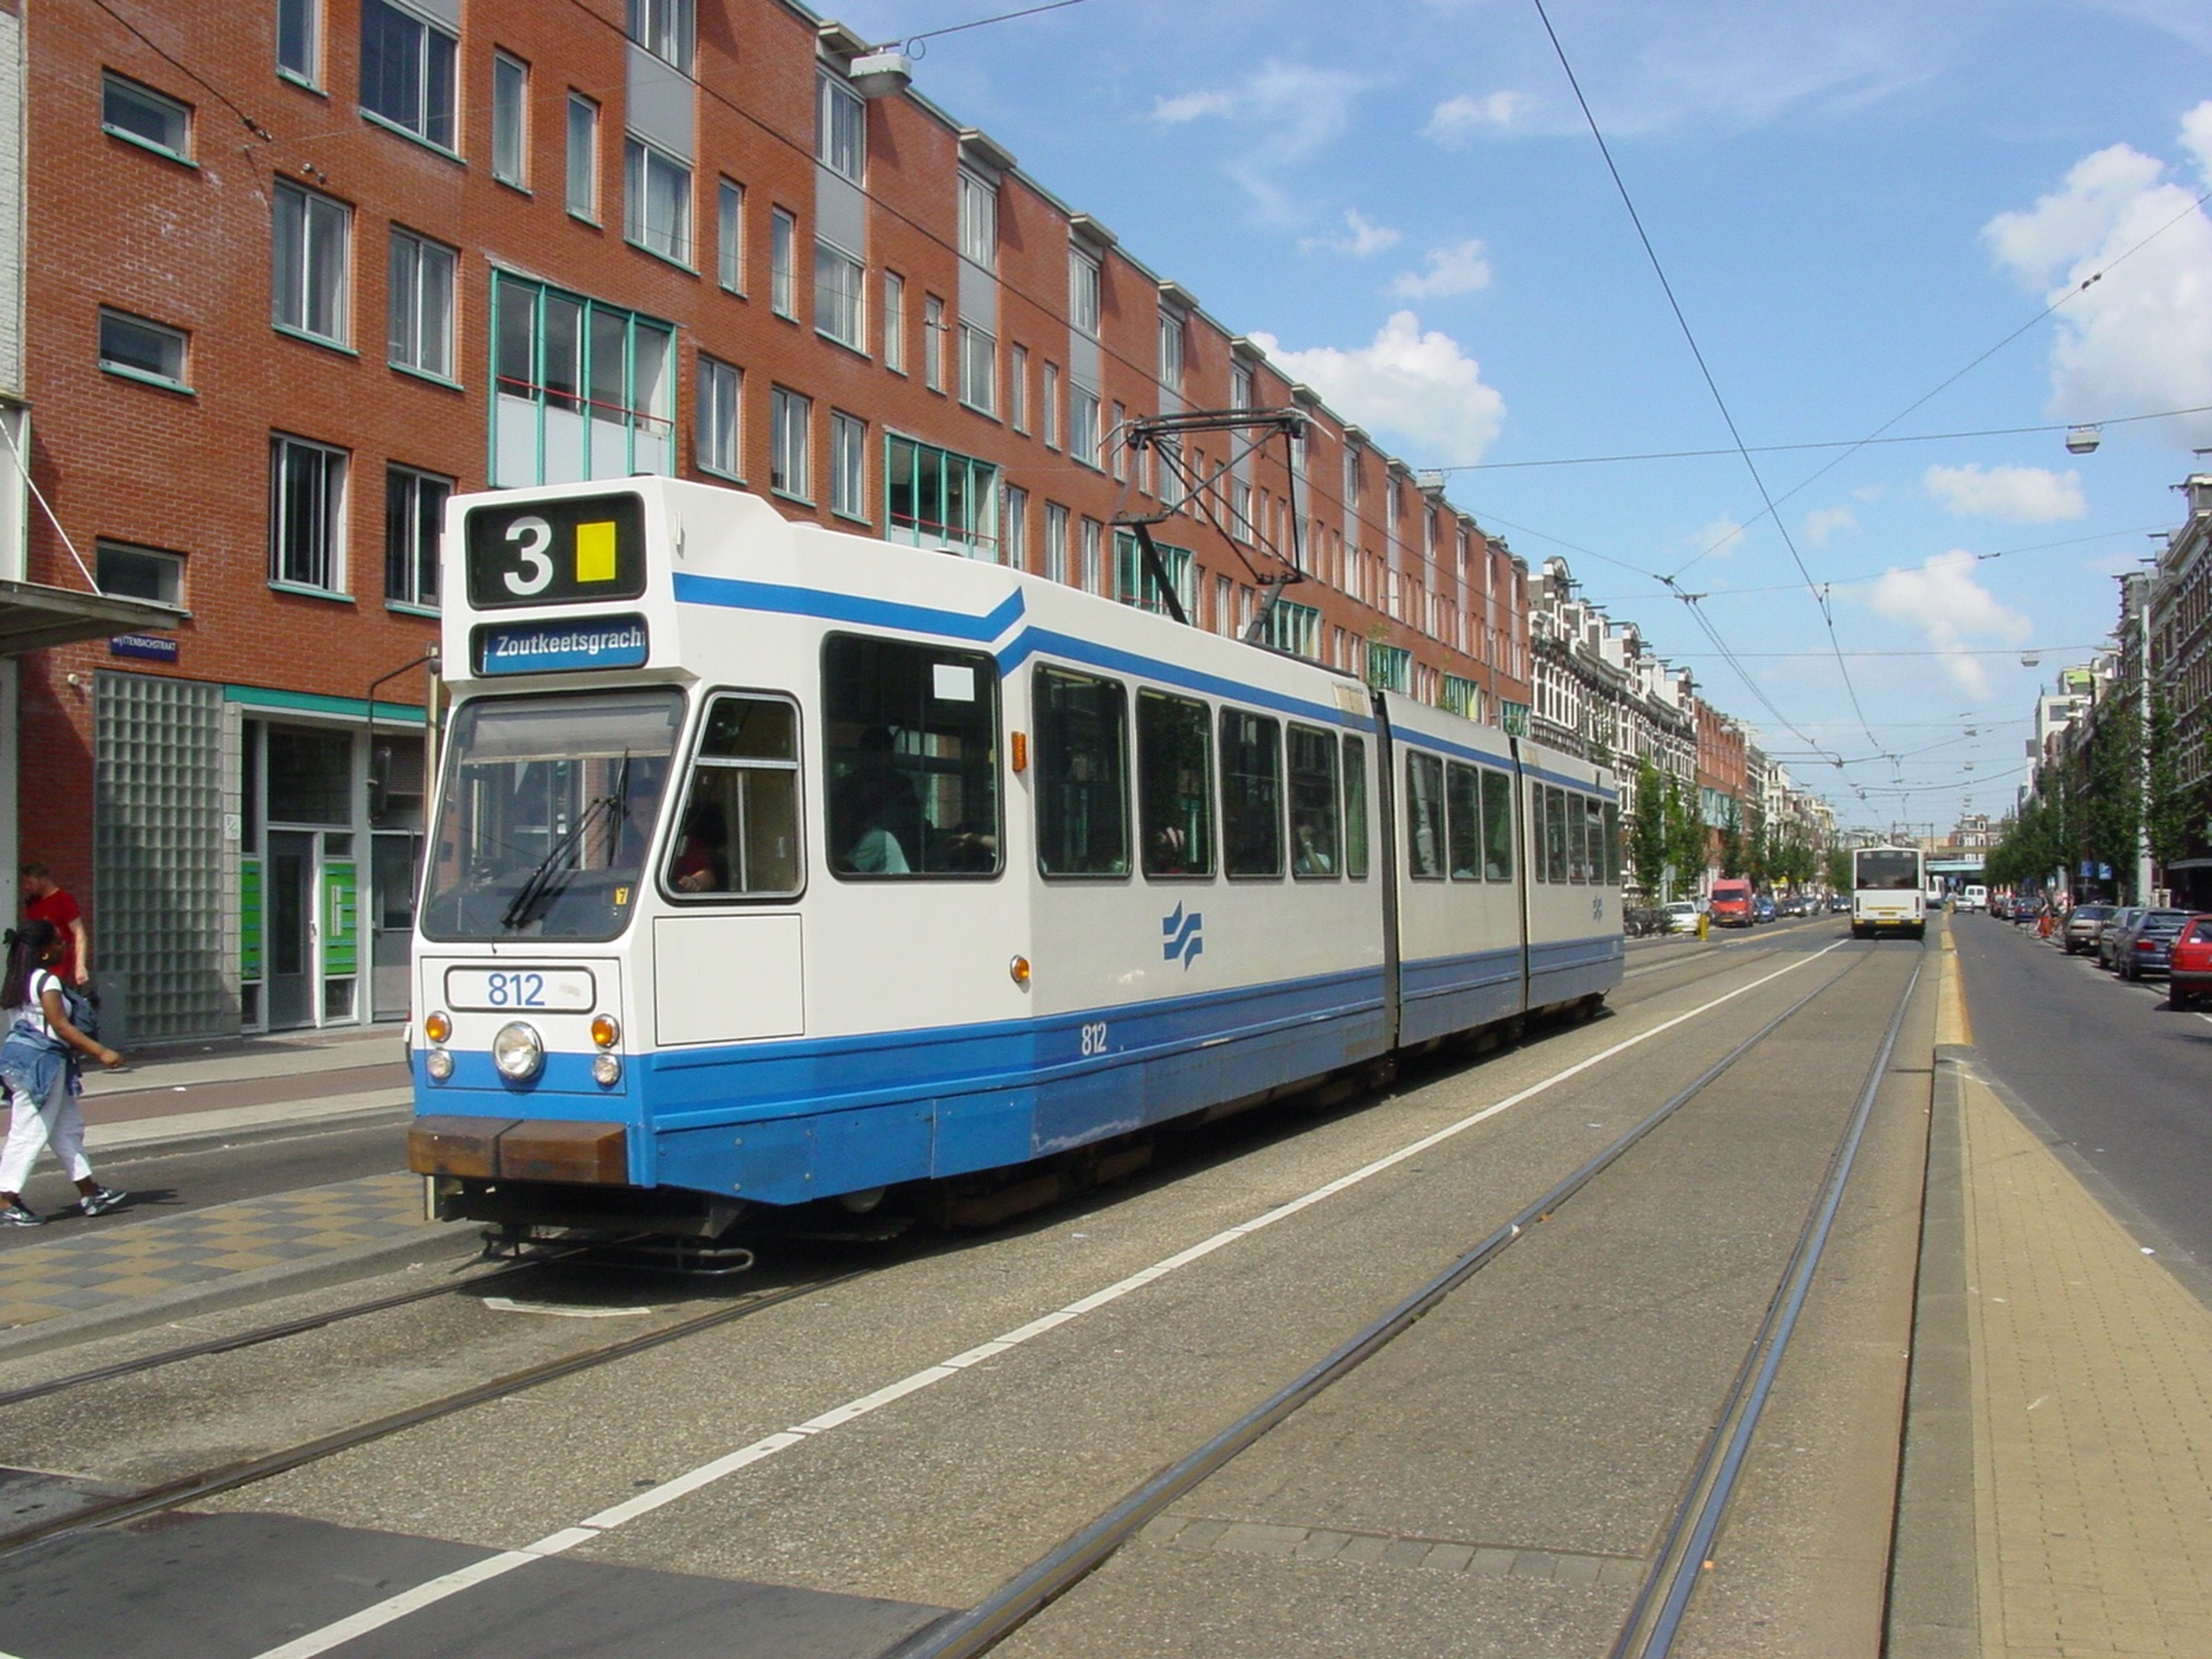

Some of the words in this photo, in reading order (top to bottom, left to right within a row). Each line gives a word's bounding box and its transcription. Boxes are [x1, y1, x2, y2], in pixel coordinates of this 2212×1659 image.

[503, 516, 554, 596] 3
[488, 973, 545, 1006] 812
[1082, 1022, 1107, 1056] 812
